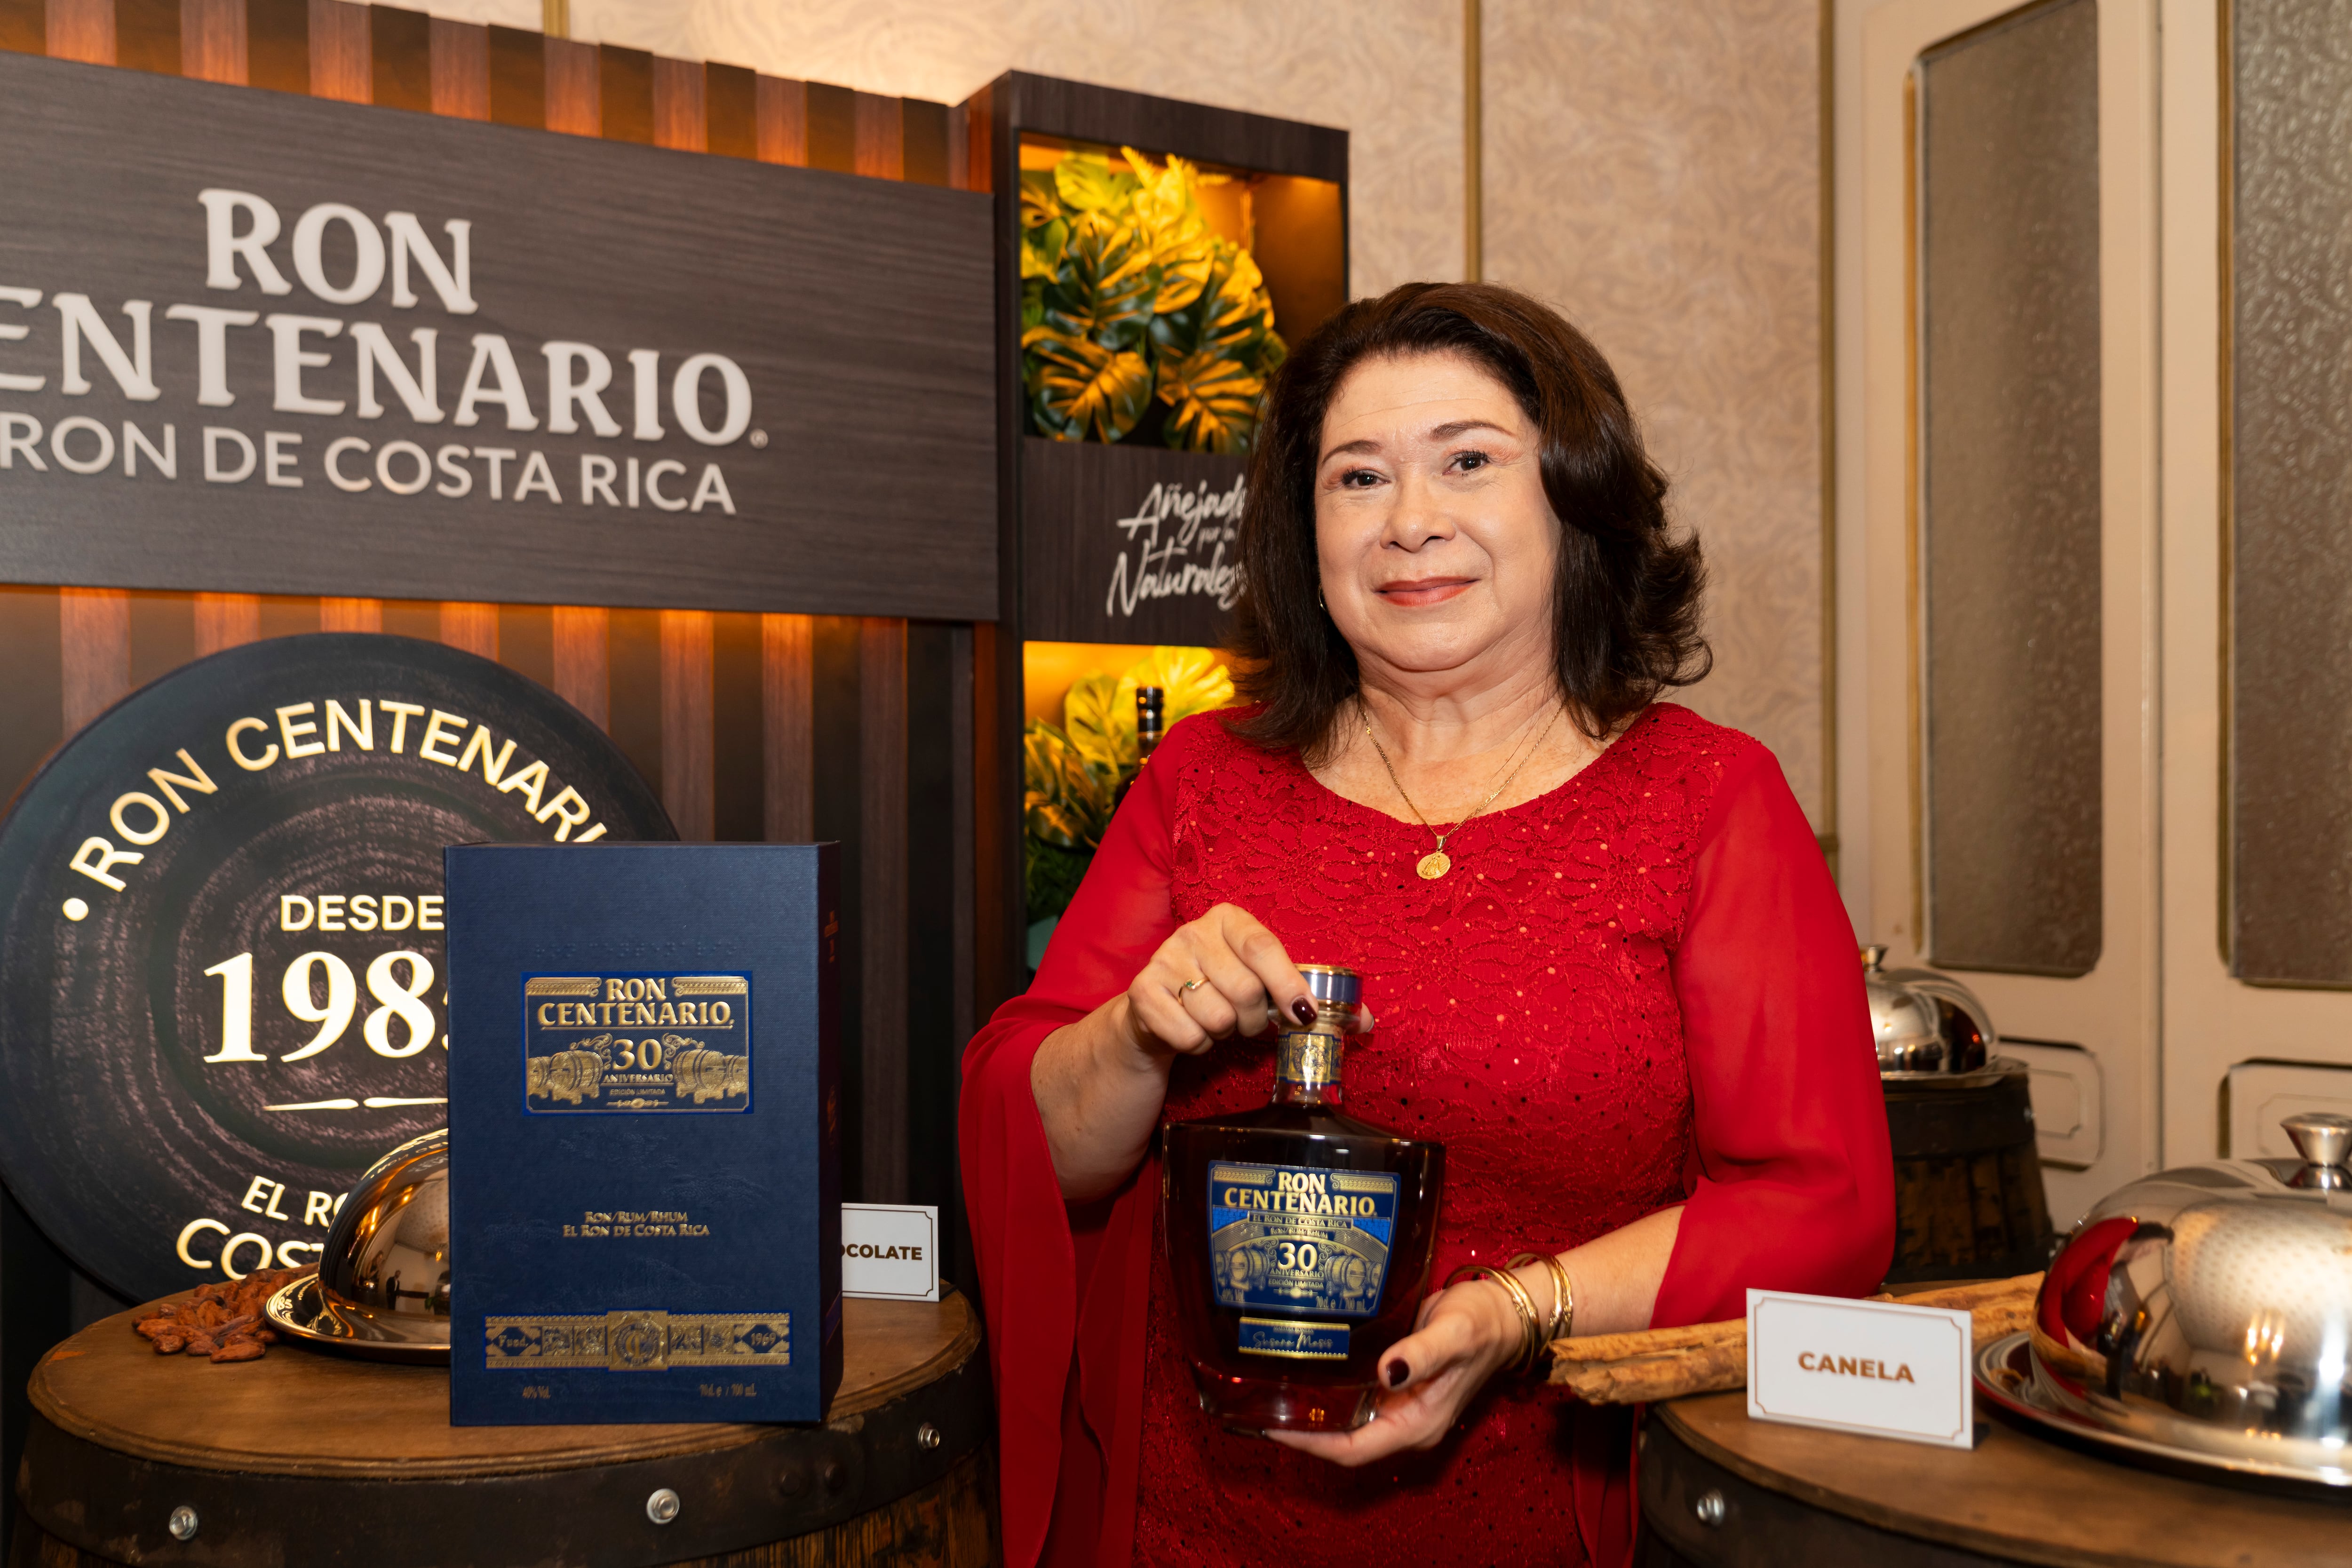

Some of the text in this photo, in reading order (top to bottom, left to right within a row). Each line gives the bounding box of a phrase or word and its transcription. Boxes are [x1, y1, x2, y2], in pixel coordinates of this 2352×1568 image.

[197, 188, 479, 315] RON
[0, 411, 737, 515] RON DE COSTA RICA
[70, 748, 218, 892] RON
[281, 895, 445, 931] DESDE
[203, 950, 448, 1063] 198
[605, 978, 667, 1002] RON
[537, 1002, 732, 1026] CENTENARIO
[613, 1038, 663, 1071] 30
[603, 1074, 674, 1083] ANIVERSARIO
[241, 1175, 289, 1221] EL
[1278, 1171, 1326, 1194] RON
[1224, 1187, 1375, 1216] CENTENARIO
[176, 1218, 324, 1281] COS
[1278, 1242, 1317, 1271] 30
[1268, 1278, 1324, 1289] EDICIÓN LIMITADA
[1270, 1267, 1324, 1278] ANIVERSARIO
[1798, 1351, 1915, 1384] CANELA
